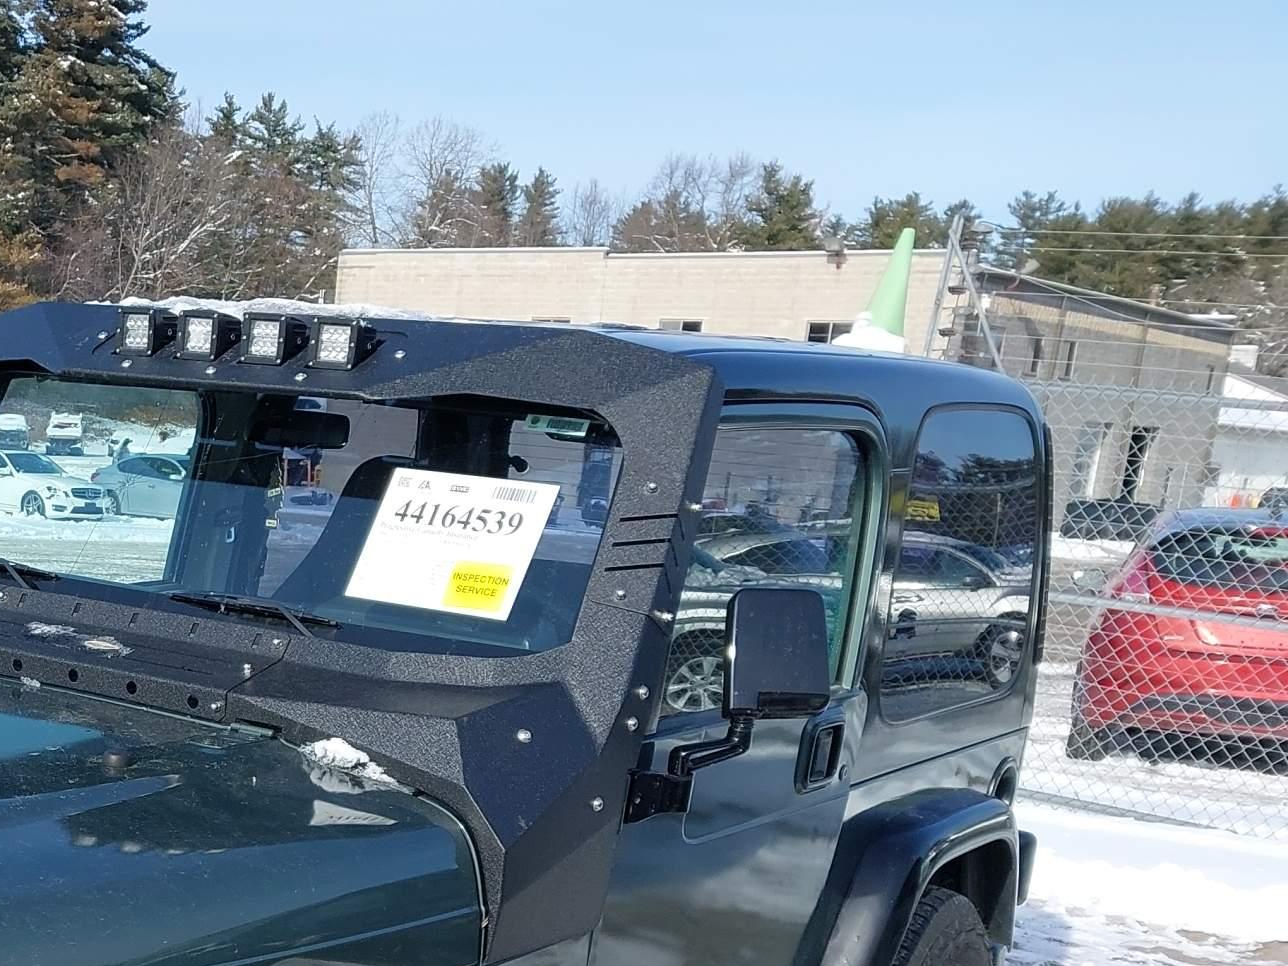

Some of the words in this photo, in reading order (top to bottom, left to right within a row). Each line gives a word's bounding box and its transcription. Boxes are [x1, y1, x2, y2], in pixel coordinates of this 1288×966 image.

[394, 499, 524, 535] 44164539
[453, 572, 510, 586] INSPECTION
[455, 584, 497, 597] SERVICE
